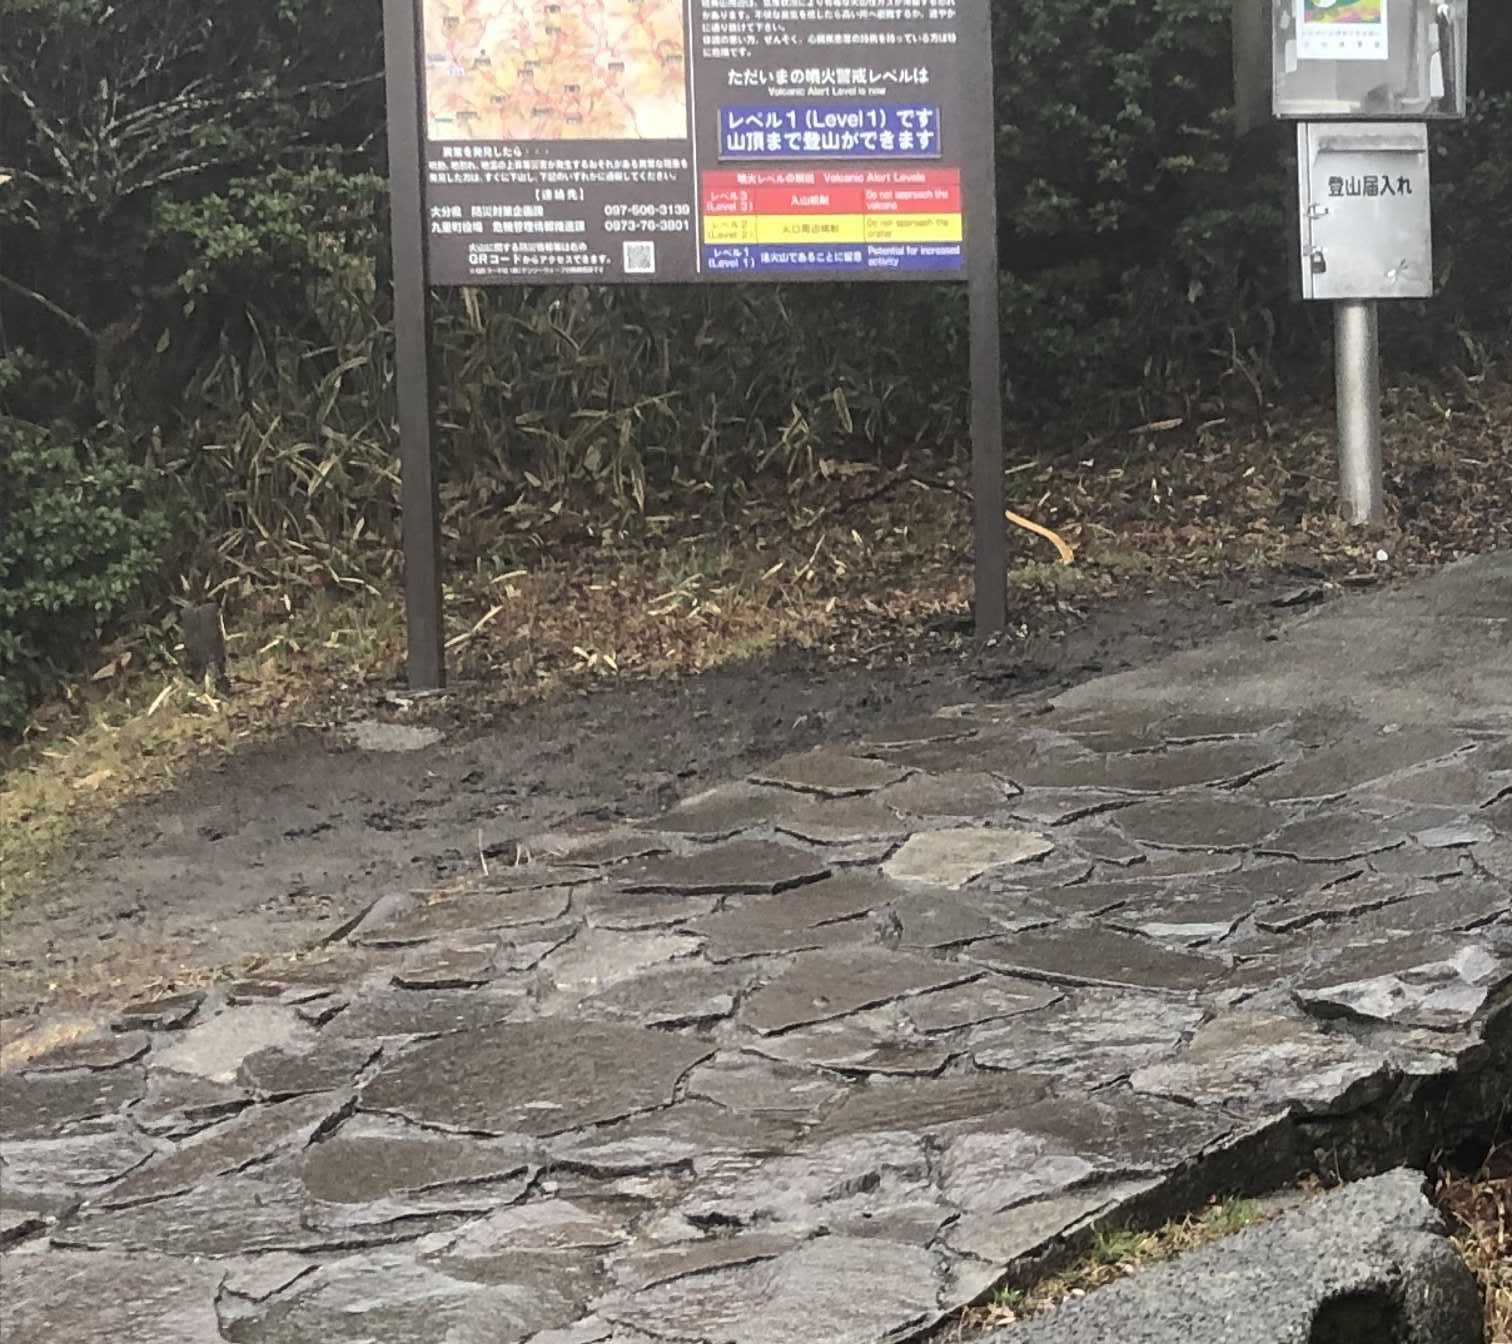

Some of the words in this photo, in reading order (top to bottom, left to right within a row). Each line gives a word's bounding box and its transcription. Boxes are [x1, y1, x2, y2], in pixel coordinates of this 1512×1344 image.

[728, 67, 929, 86] ただいまの噴火警戒レベルは
[727, 130, 934, 151] 山頂まで登山ができます
[1328, 175, 1413, 197] 登山届入れ
